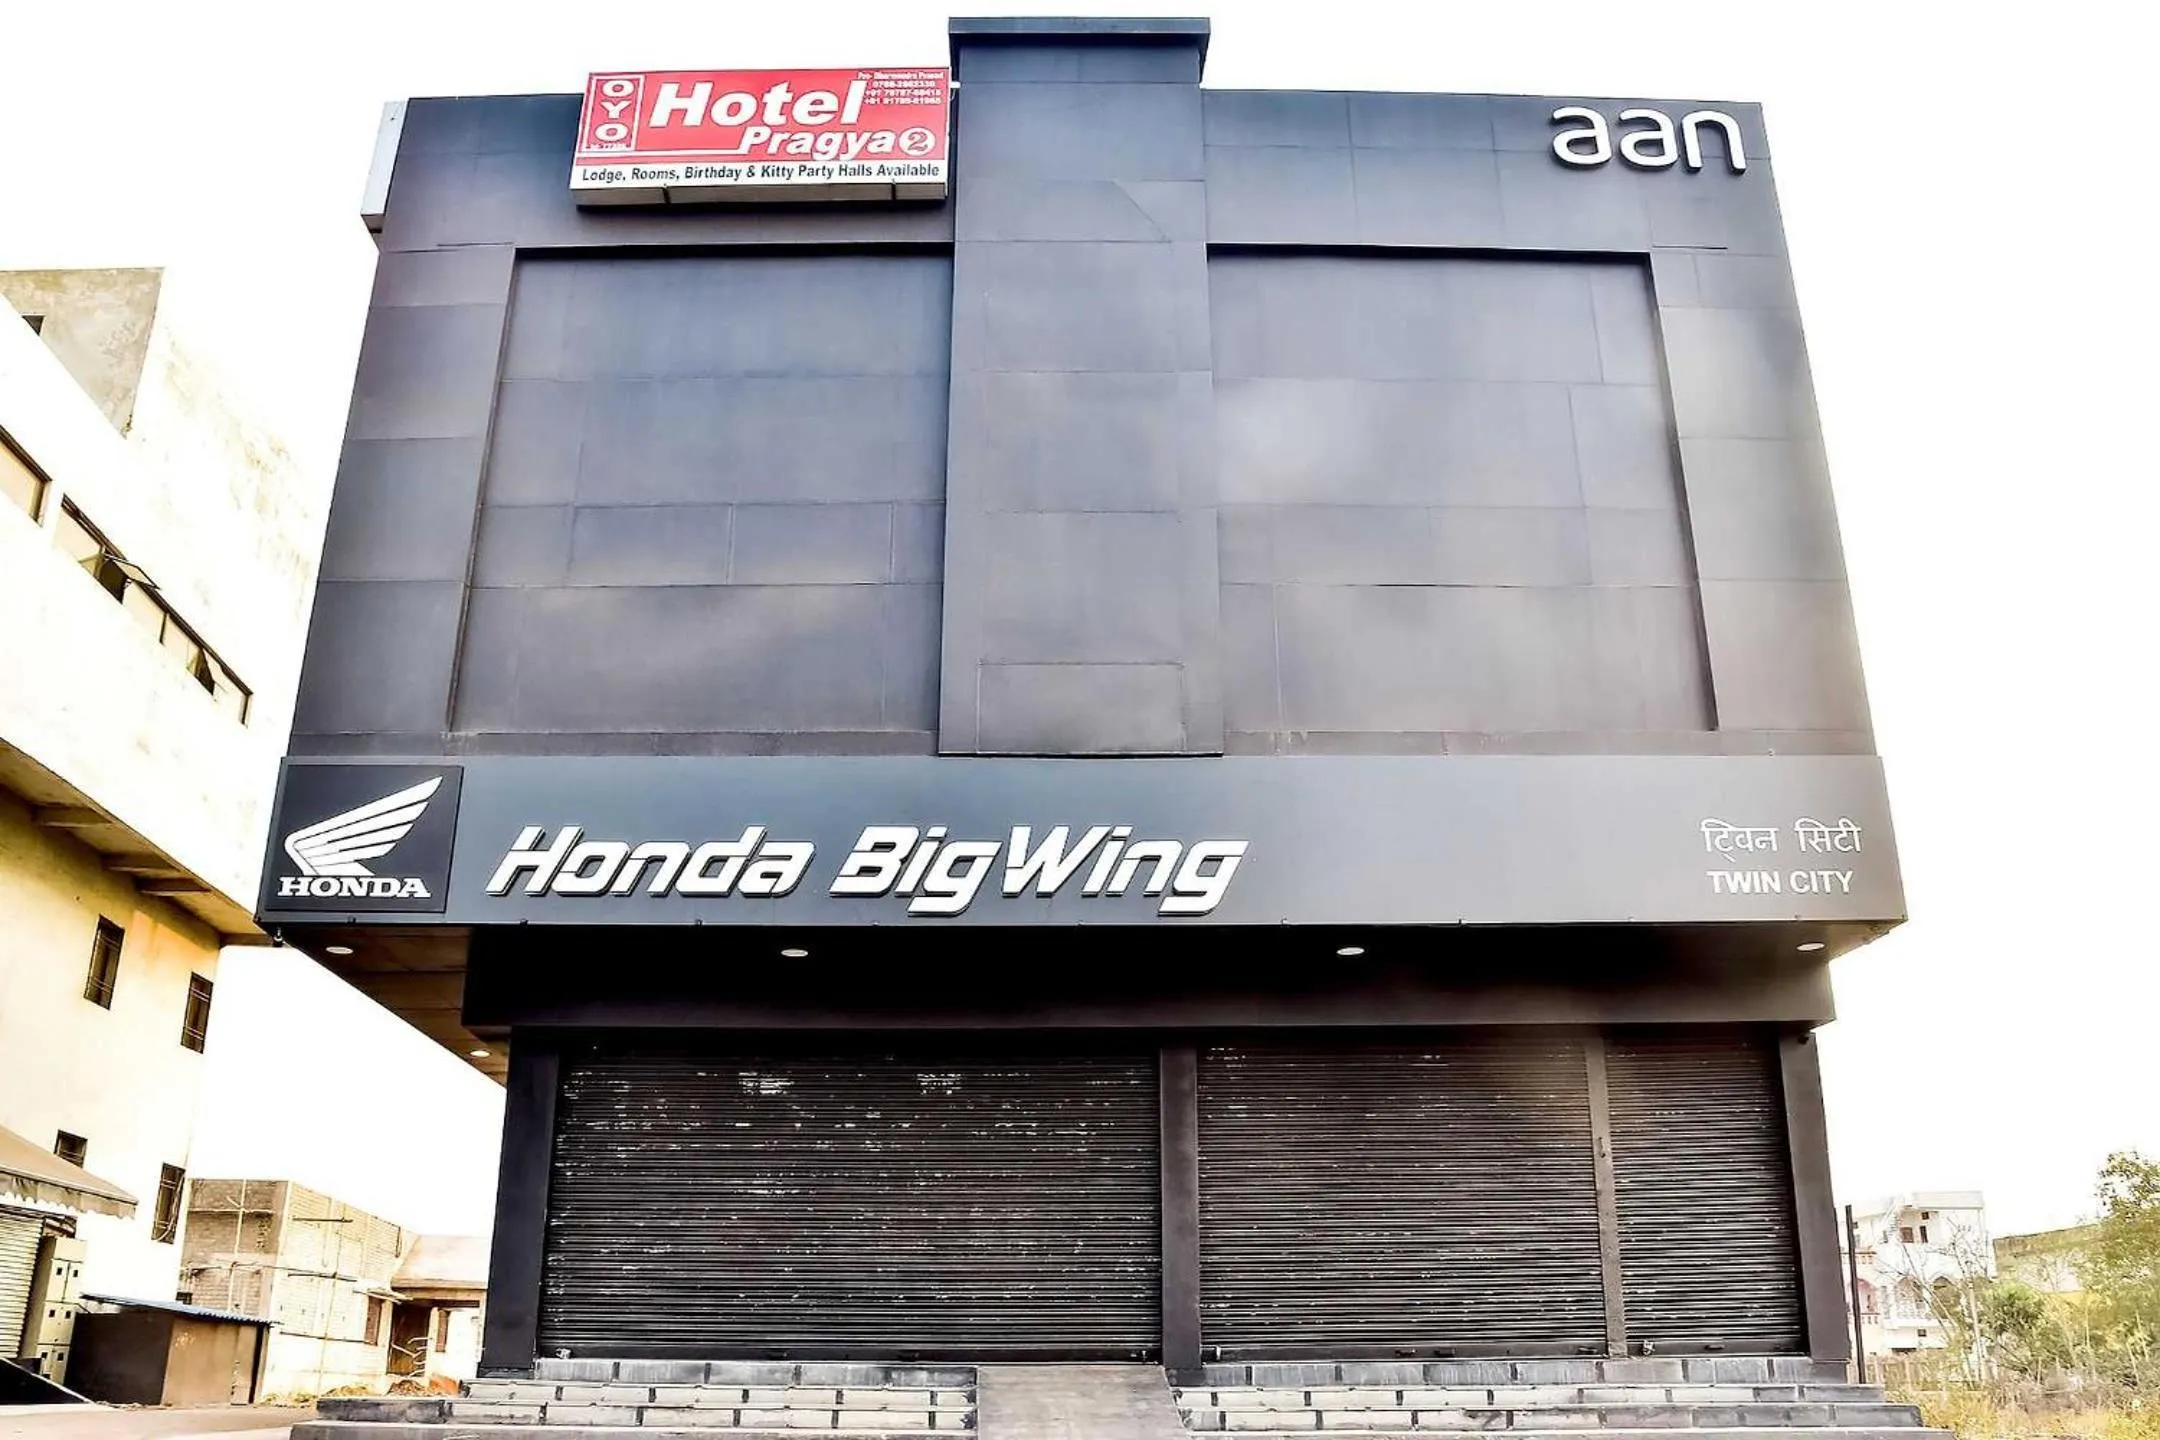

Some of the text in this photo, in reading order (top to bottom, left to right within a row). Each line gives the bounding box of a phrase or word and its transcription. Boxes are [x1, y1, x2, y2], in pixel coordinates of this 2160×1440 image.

[594, 79, 635, 142] OYO
[650, 80, 868, 129] Hotel
[738, 126, 897, 162] Pragya
[1551, 106, 1747, 172] aan
[582, 163, 940, 184] Lodge, Rooms, Birthday & Kitty Party Halls Available
[1795, 816, 1862, 853] सिटी
[485, 825, 816, 899] Honda
[278, 875, 431, 899] HONDA
[1706, 870, 1854, 894] TWIN CITY
